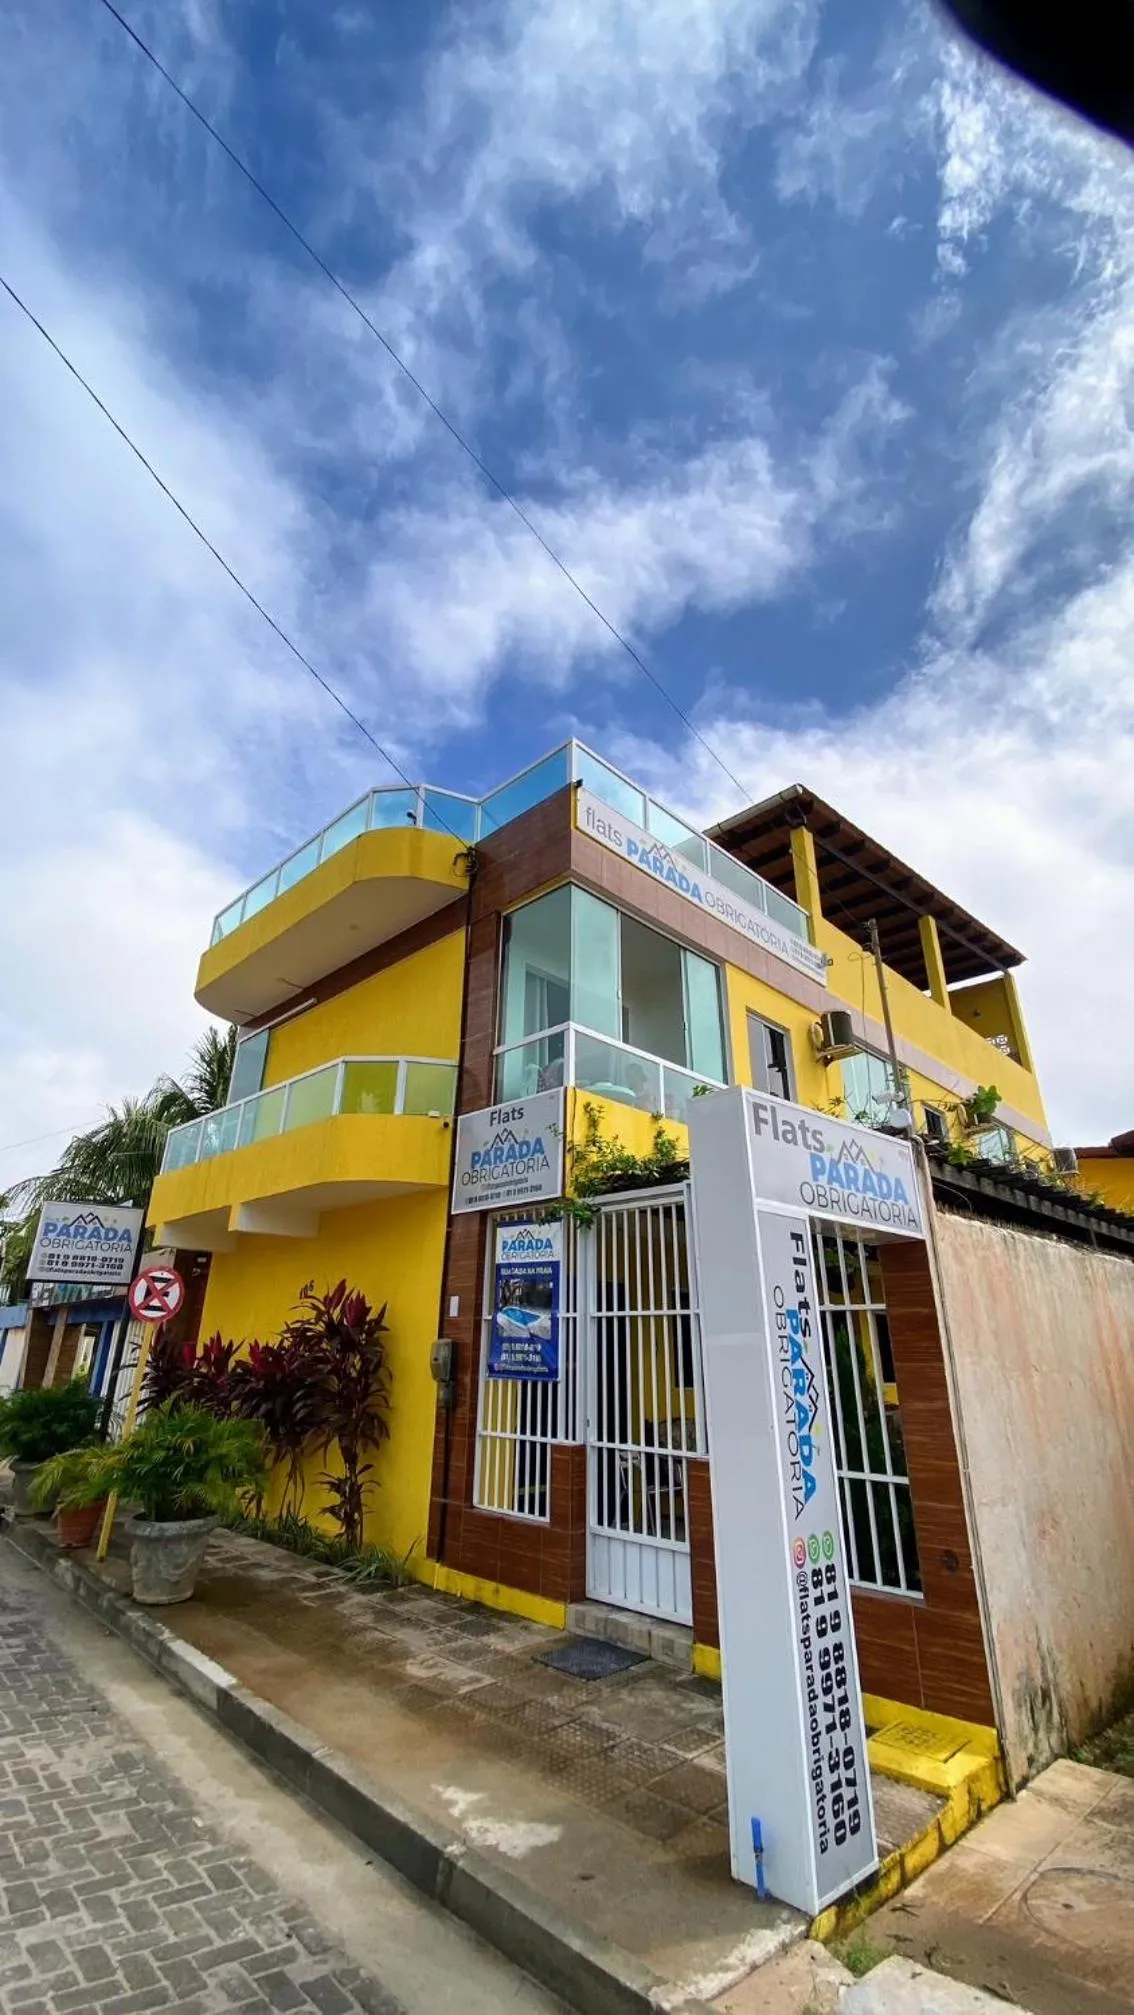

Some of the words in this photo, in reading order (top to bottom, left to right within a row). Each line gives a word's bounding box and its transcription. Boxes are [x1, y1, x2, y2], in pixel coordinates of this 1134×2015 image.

[586, 807, 622, 848] flats
[626, 838, 704, 903] PARADA
[704, 890, 789, 956] OBRIGATORIA
[489, 1106, 524, 1127] Flats
[752, 1102, 826, 1153] Flats
[461, 1155, 550, 1187] OBRIGATORIA
[471, 1137, 545, 1169] PARADA
[809, 1152, 909, 1205] PARADA
[800, 1181, 918, 1229] OBRIGATORIA
[40, 1238, 133, 1253] OBRIGATORIA
[42, 1222, 132, 1243] PARADA
[502, 1238, 553, 1252] PARADA
[790, 1231, 812, 1338] Flats
[773, 1285, 805, 1521] OBRIGATORIA
[785, 1308, 817, 1505] PARADA
[811, 1567, 826, 1606] 81
[825, 1563, 839, 1602] 81
[815, 1615, 828, 1639] 9
[830, 1610, 842, 1633] 9
[796, 1571, 830, 1855] @flatsparadaobrigatoria
[818, 1647, 847, 1846] 9971-3160
[833, 1641, 861, 1836] 8818-0719
